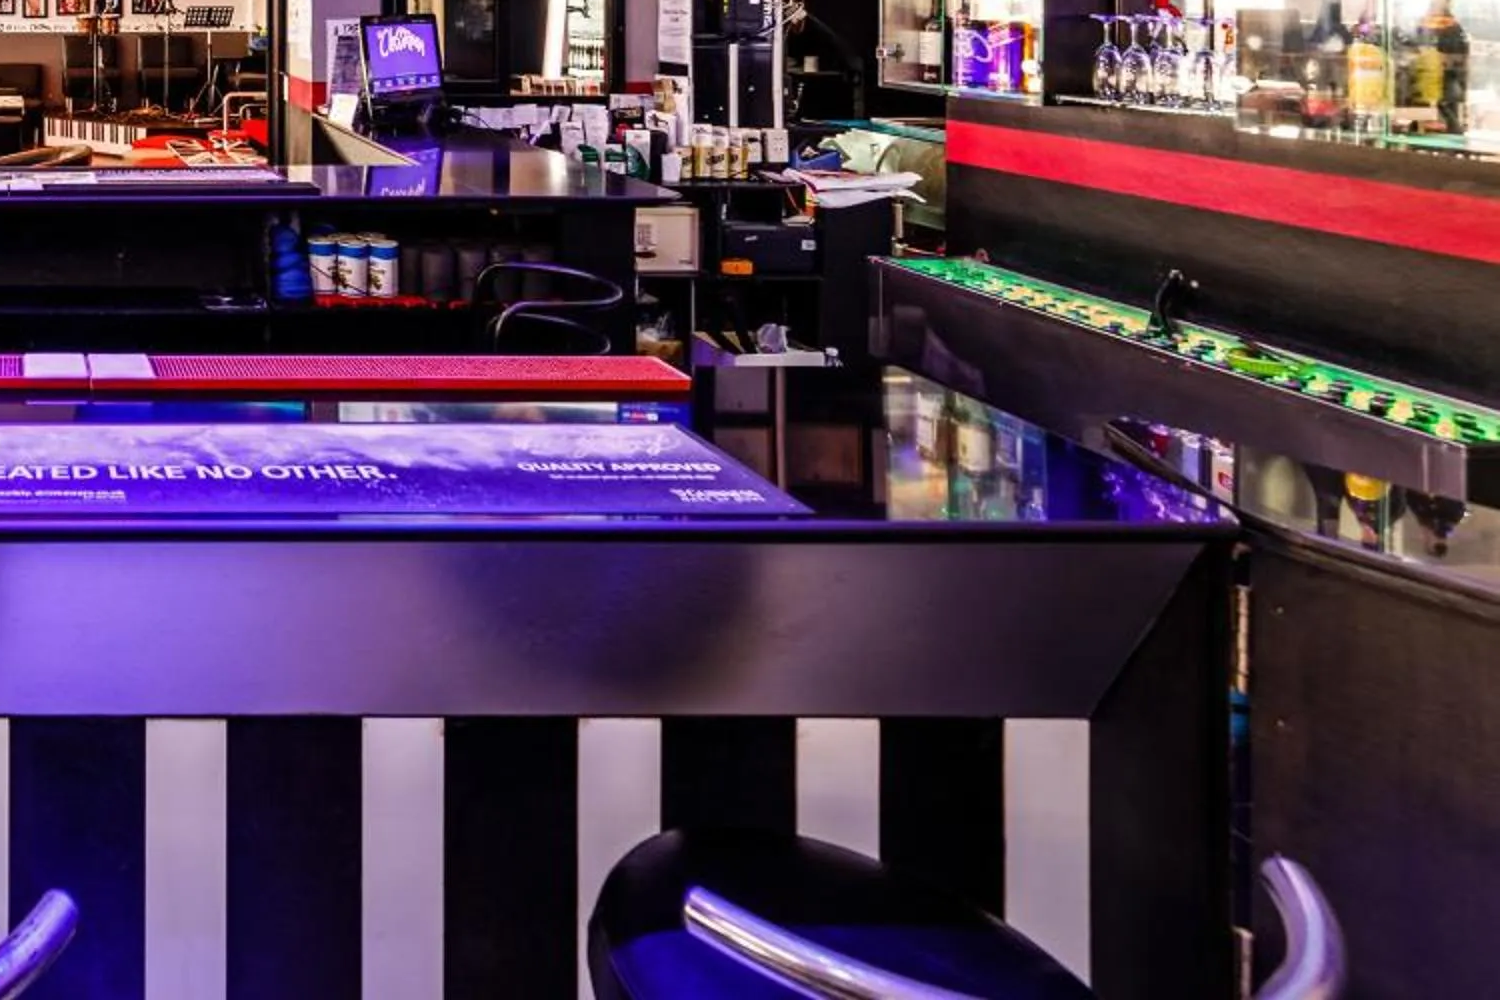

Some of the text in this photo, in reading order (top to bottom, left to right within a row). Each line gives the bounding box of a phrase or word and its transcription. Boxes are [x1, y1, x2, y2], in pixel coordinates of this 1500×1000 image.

[108, 465, 187, 480] LIKE
[196, 465, 253, 480] NO
[261, 465, 399, 480] OTHER.
[517, 462, 722, 473] QUALITY APPROVED
